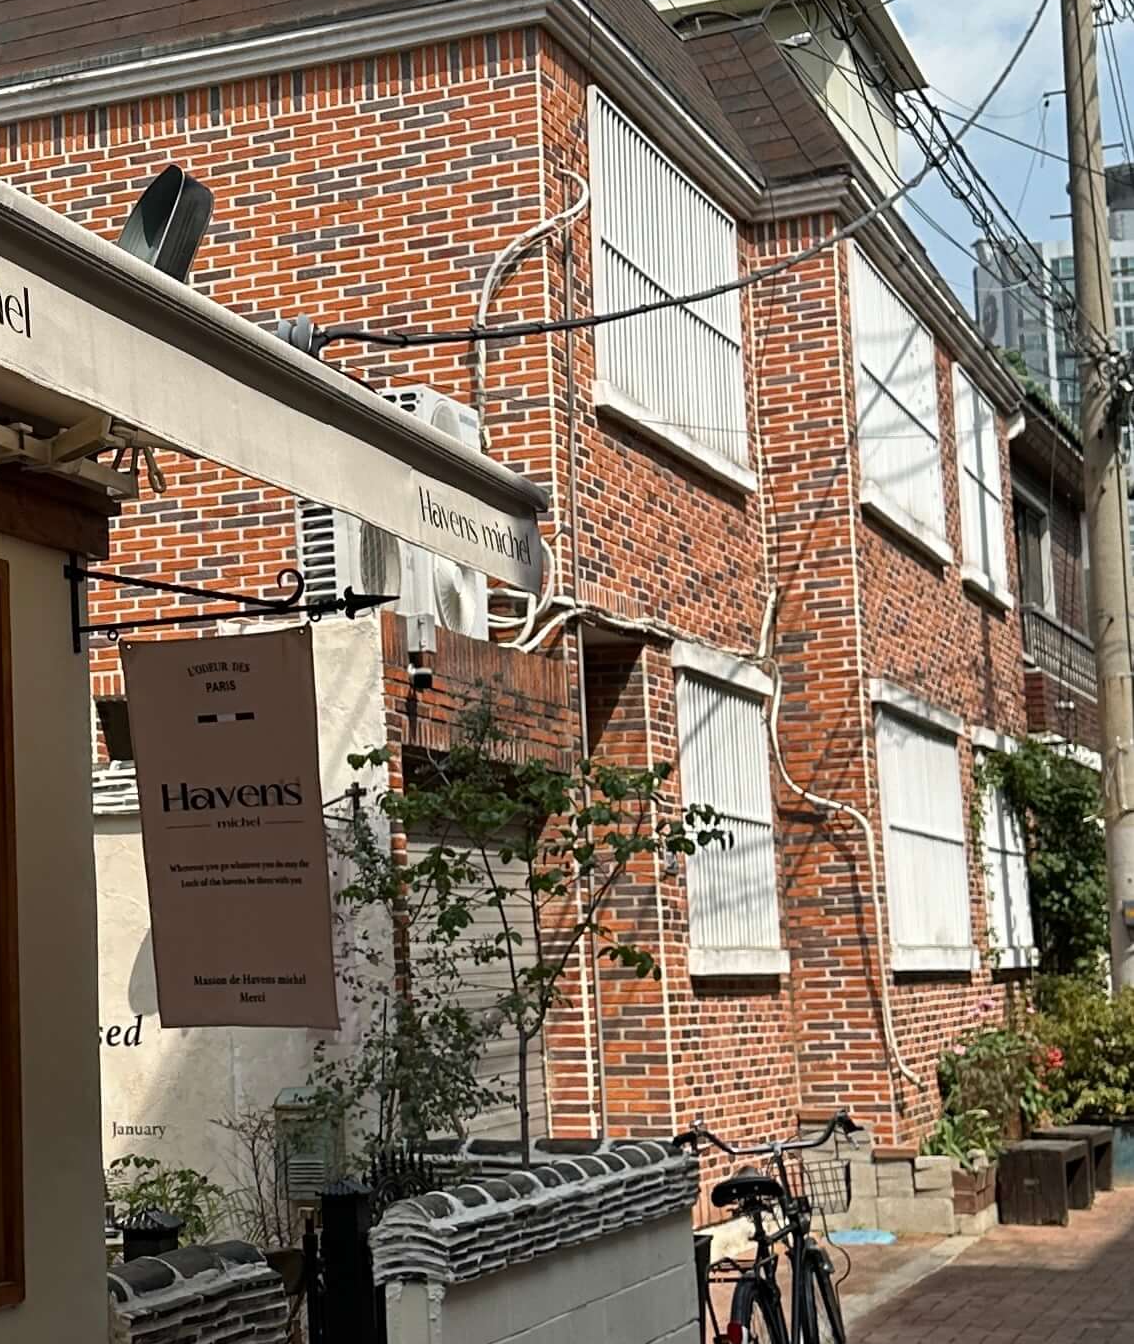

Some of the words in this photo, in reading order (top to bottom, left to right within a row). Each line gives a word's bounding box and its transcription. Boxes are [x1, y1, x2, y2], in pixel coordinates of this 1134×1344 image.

[418, 485, 479, 545] Havens
[481, 520, 532, 566] michel
[205, 679, 237, 693] PARIS
[161, 782, 303, 813] Havens
[217, 816, 261, 830] michel
[228, 973, 242, 985] de
[242, 973, 276, 985] Havens
[239, 992, 267, 1003] Merci
[111, 1121, 167, 1139] January
